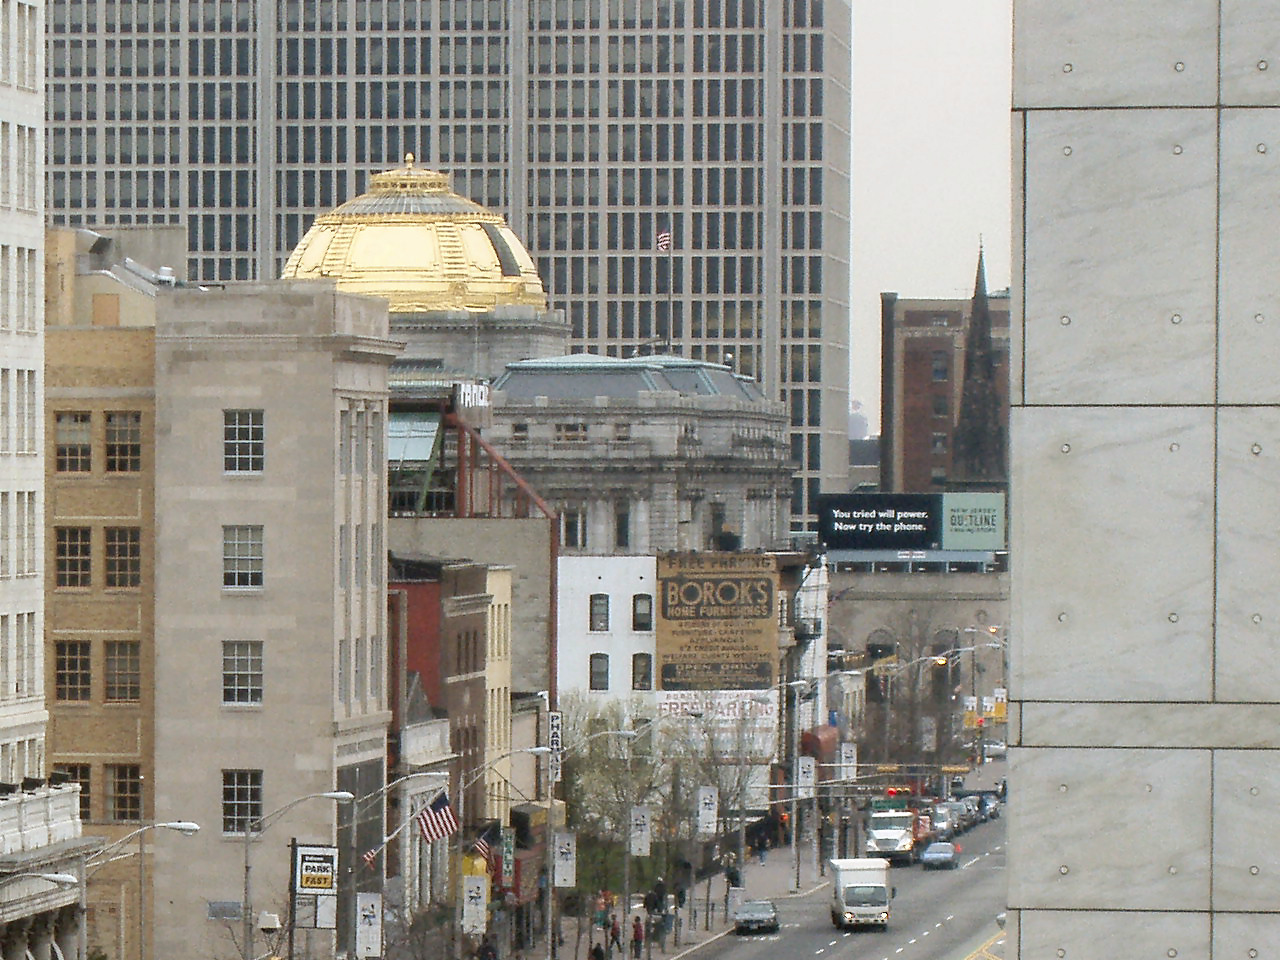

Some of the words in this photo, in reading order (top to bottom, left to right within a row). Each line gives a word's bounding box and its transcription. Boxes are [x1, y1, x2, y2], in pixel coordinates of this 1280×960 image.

[833, 509, 851, 518] You
[852, 509, 876, 518] tried
[878, 509, 895, 518] will
[834, 522, 857, 531] Now
[858, 522, 874, 533] try
[875, 522, 892, 531] the
[667, 581, 768, 605] BOROK'S
[667, 605, 696, 617] HOME
[305, 864, 332, 873] PARK
[304, 876, 329, 885] FAST
